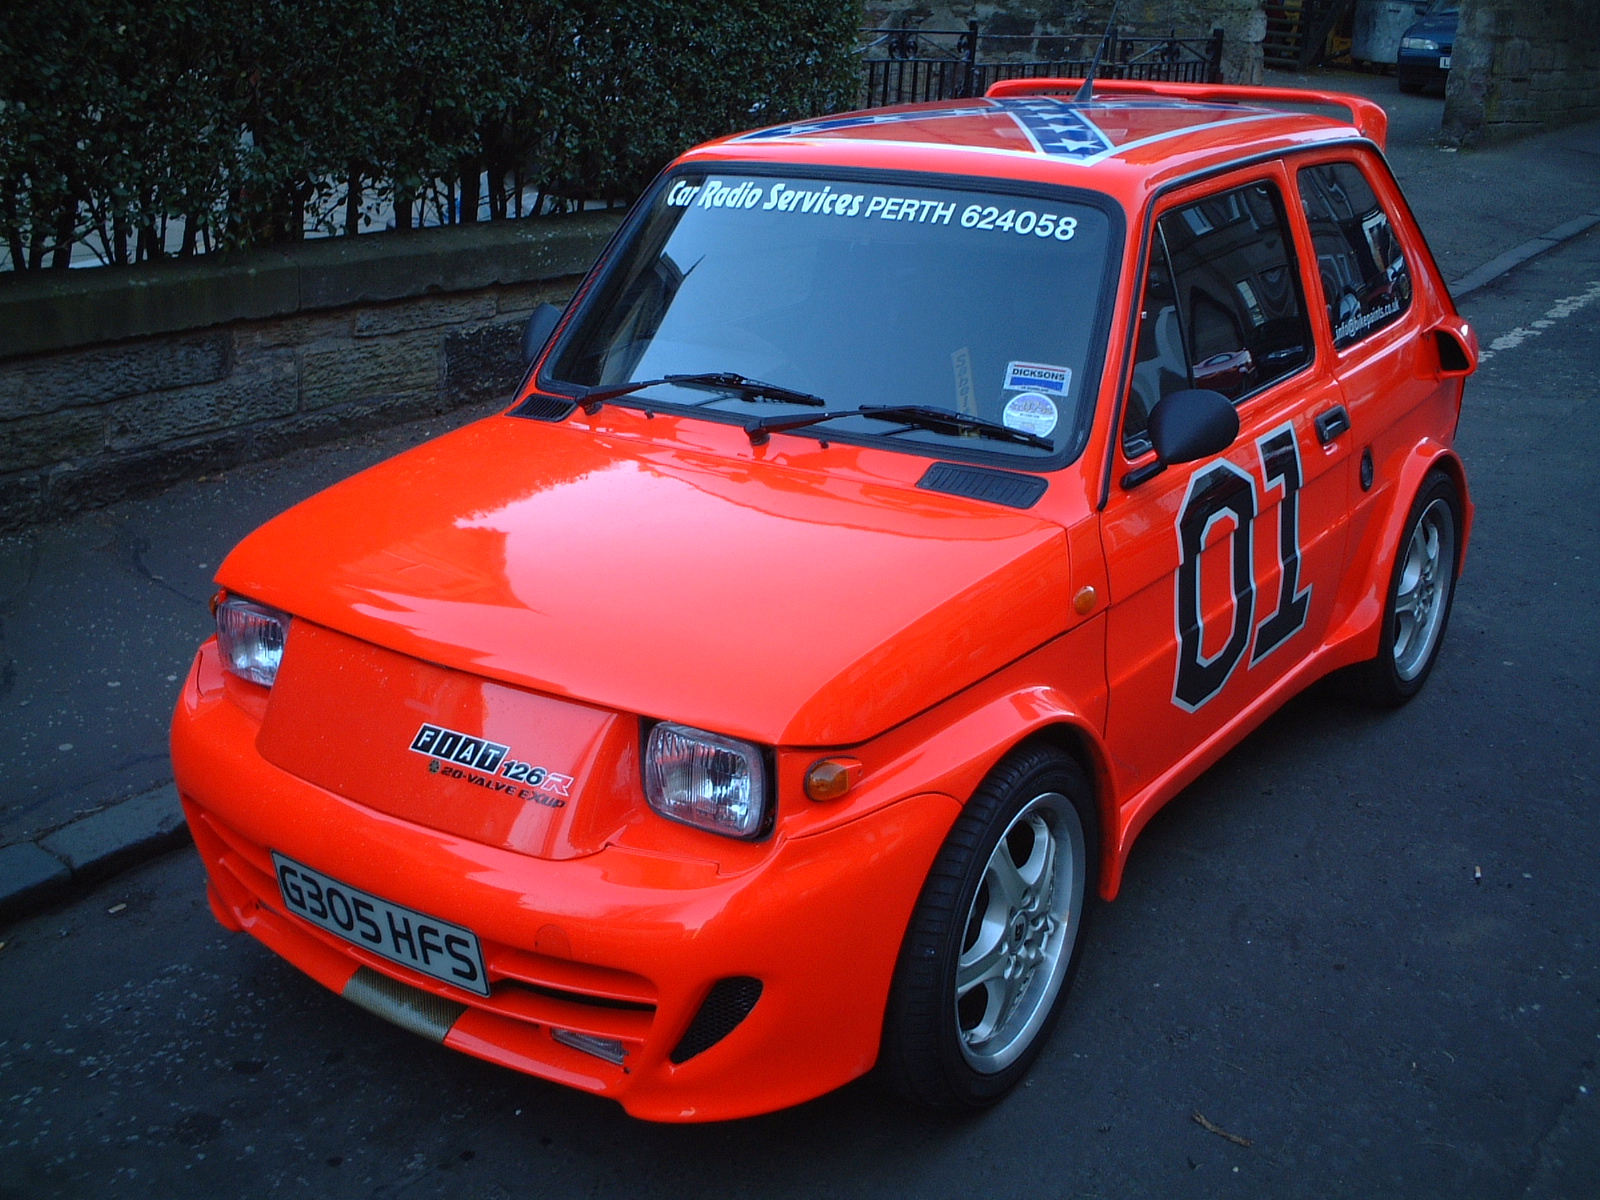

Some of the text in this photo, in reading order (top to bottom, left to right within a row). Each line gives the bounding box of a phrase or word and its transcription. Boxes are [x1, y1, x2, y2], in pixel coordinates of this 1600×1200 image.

[667, 180, 1078, 241] Car Radio Services PERTH 624058
[1012, 367, 1065, 381] DICKSONS
[1171, 420, 1313, 714] 01
[415, 728, 502, 769] FIAT
[441, 765, 517, 795] 20-VALVE
[280, 865, 478, 982] G305 HFS
